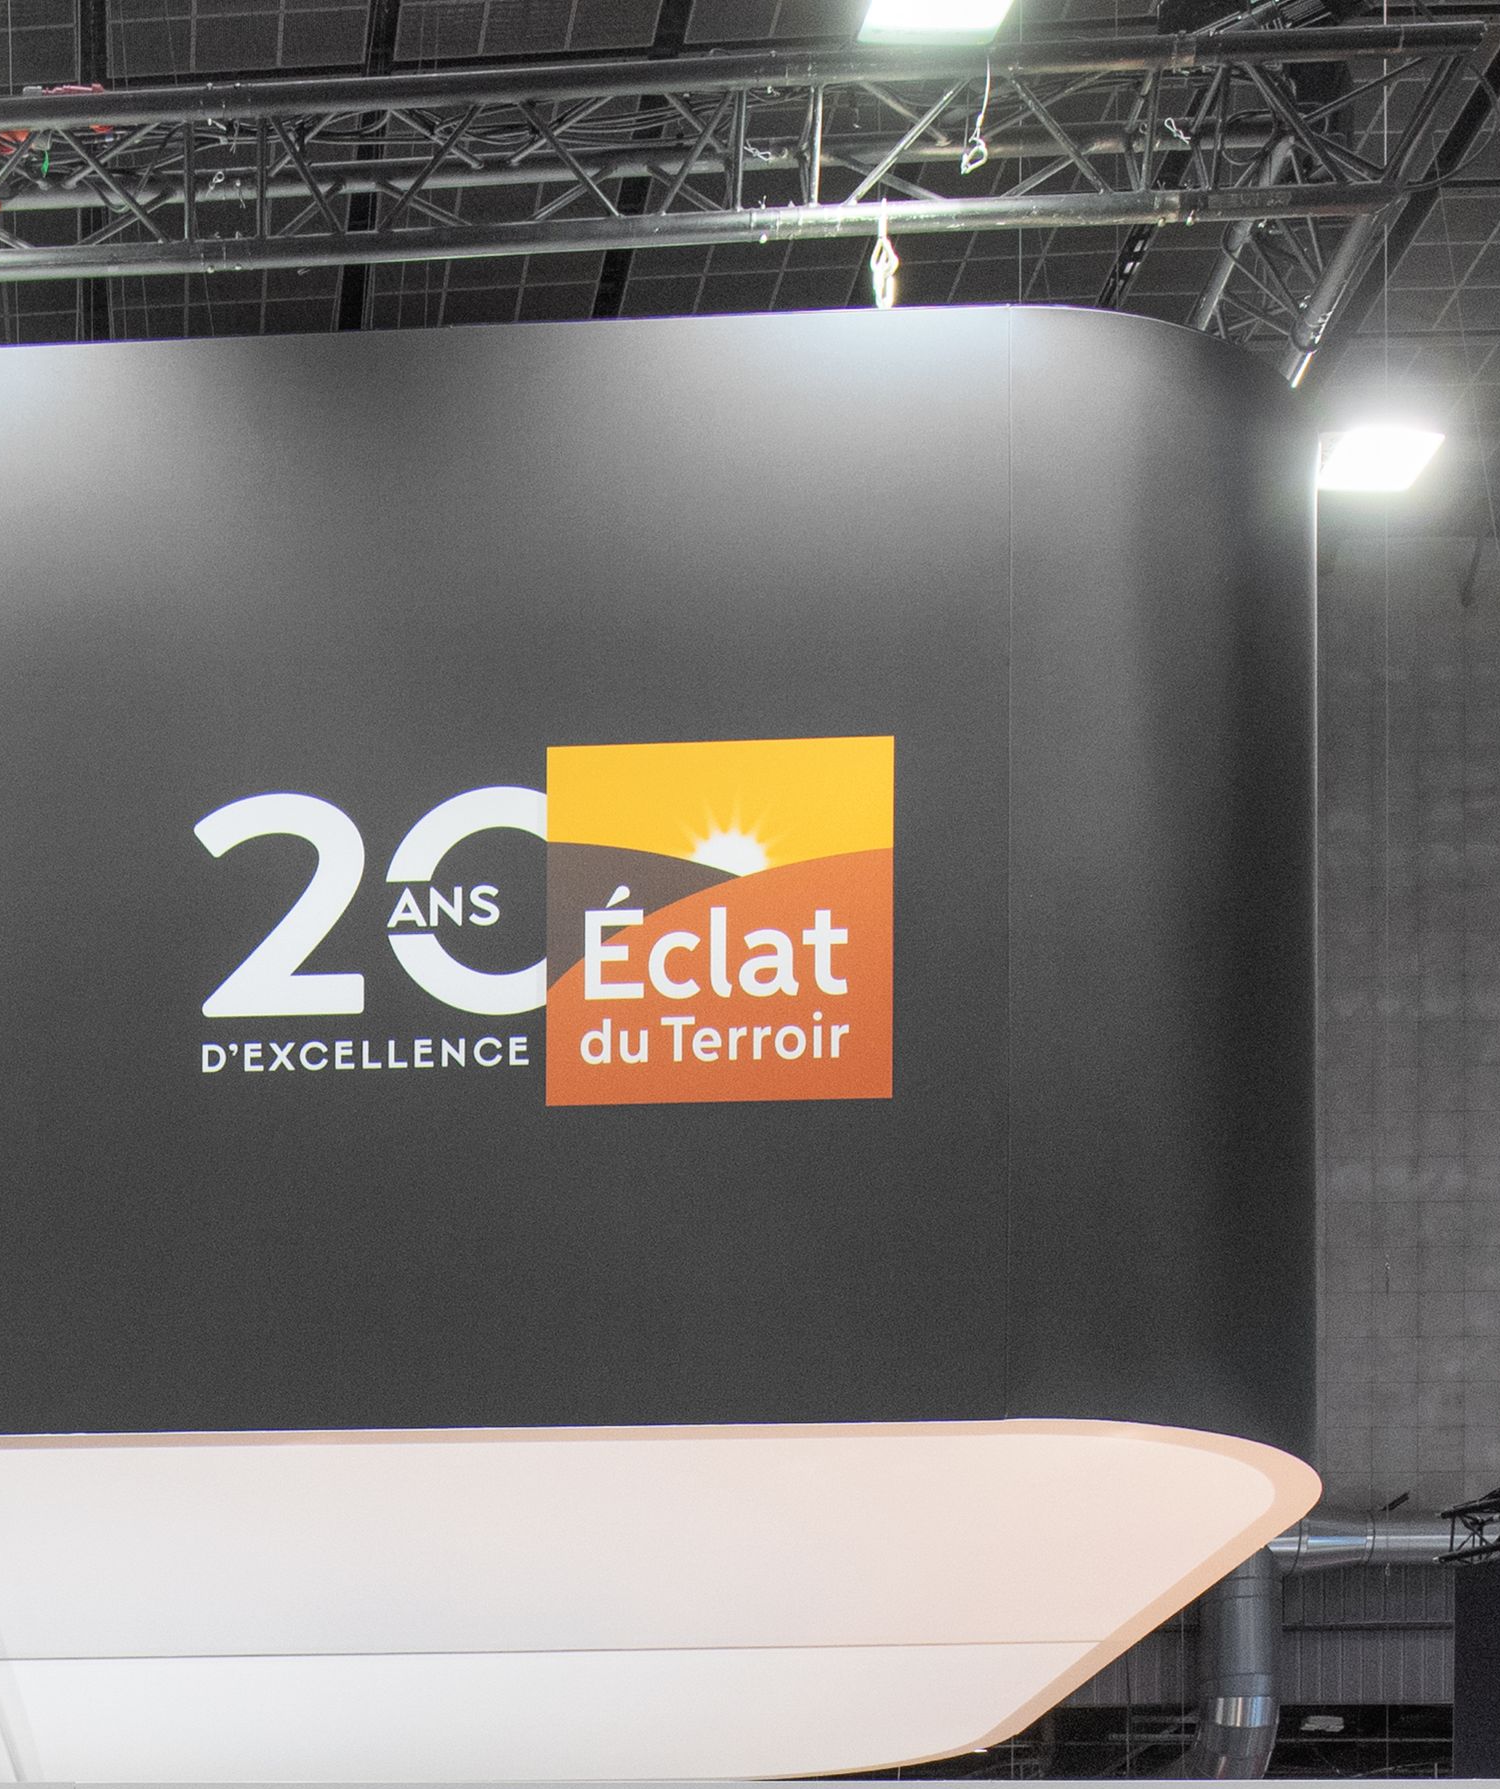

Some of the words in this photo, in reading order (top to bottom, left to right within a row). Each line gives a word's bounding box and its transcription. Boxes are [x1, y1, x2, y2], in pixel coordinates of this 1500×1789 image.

[385, 882, 502, 933] ANS
[582, 885, 850, 1001] Éclat
[200, 1034, 532, 1076] D'EXCELLENCE
[578, 1015, 652, 1065] du
[658, 1012, 852, 1063] Terroir
